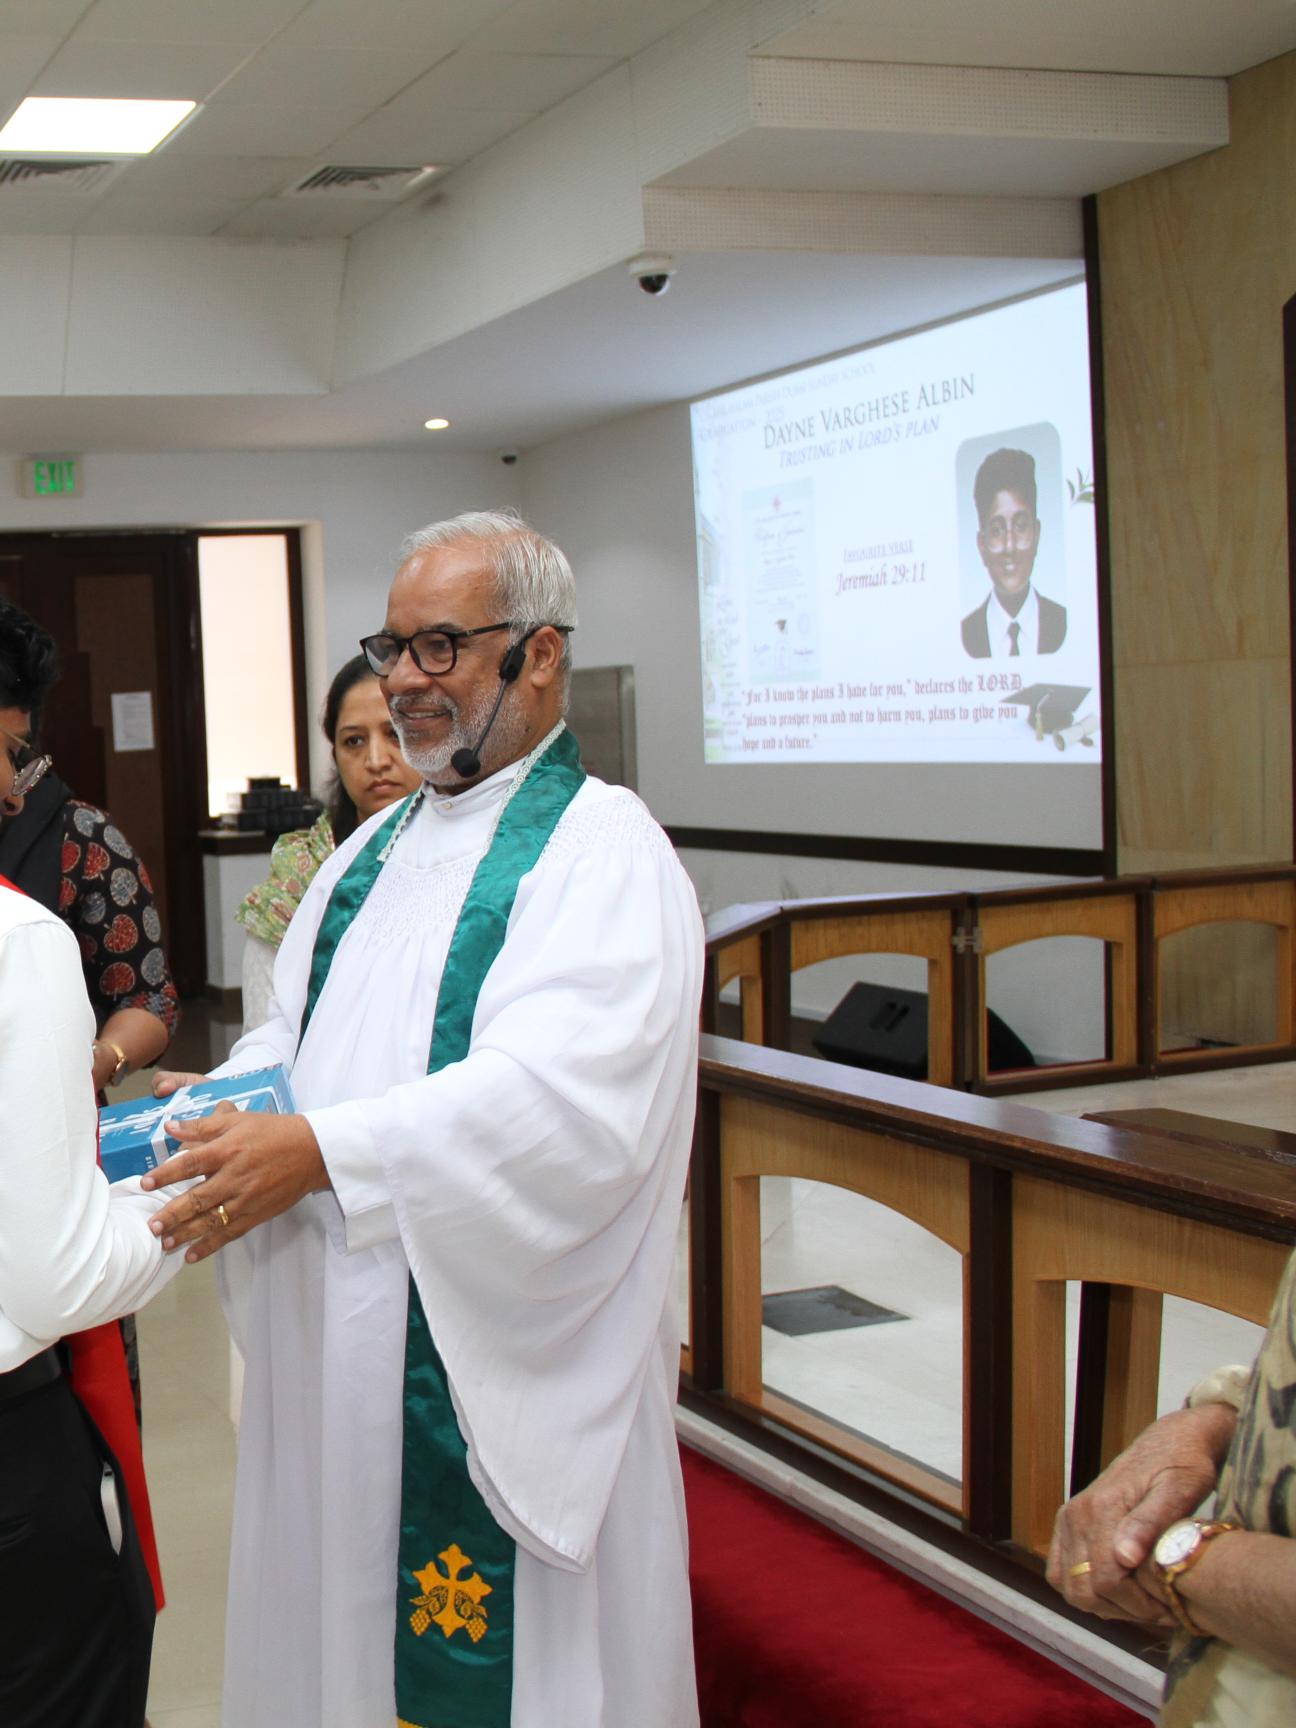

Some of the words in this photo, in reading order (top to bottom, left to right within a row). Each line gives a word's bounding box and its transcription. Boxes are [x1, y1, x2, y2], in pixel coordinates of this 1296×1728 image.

[764, 415, 816, 449] DAYNE
[819, 390, 910, 433] VARGHESE
[916, 373, 974, 410] ALBIN
[779, 440, 837, 469] TRUSTING
[838, 434, 855, 455] IN
[904, 415, 941, 439] PLAN
[33, 461, 76, 495] EXIT
[834, 562, 887, 596] Jeremiah
[890, 561, 926, 585] 29:11
[927, 705, 956, 725] plans
[958, 704, 970, 721] to
[997, 703, 1018, 722] you
